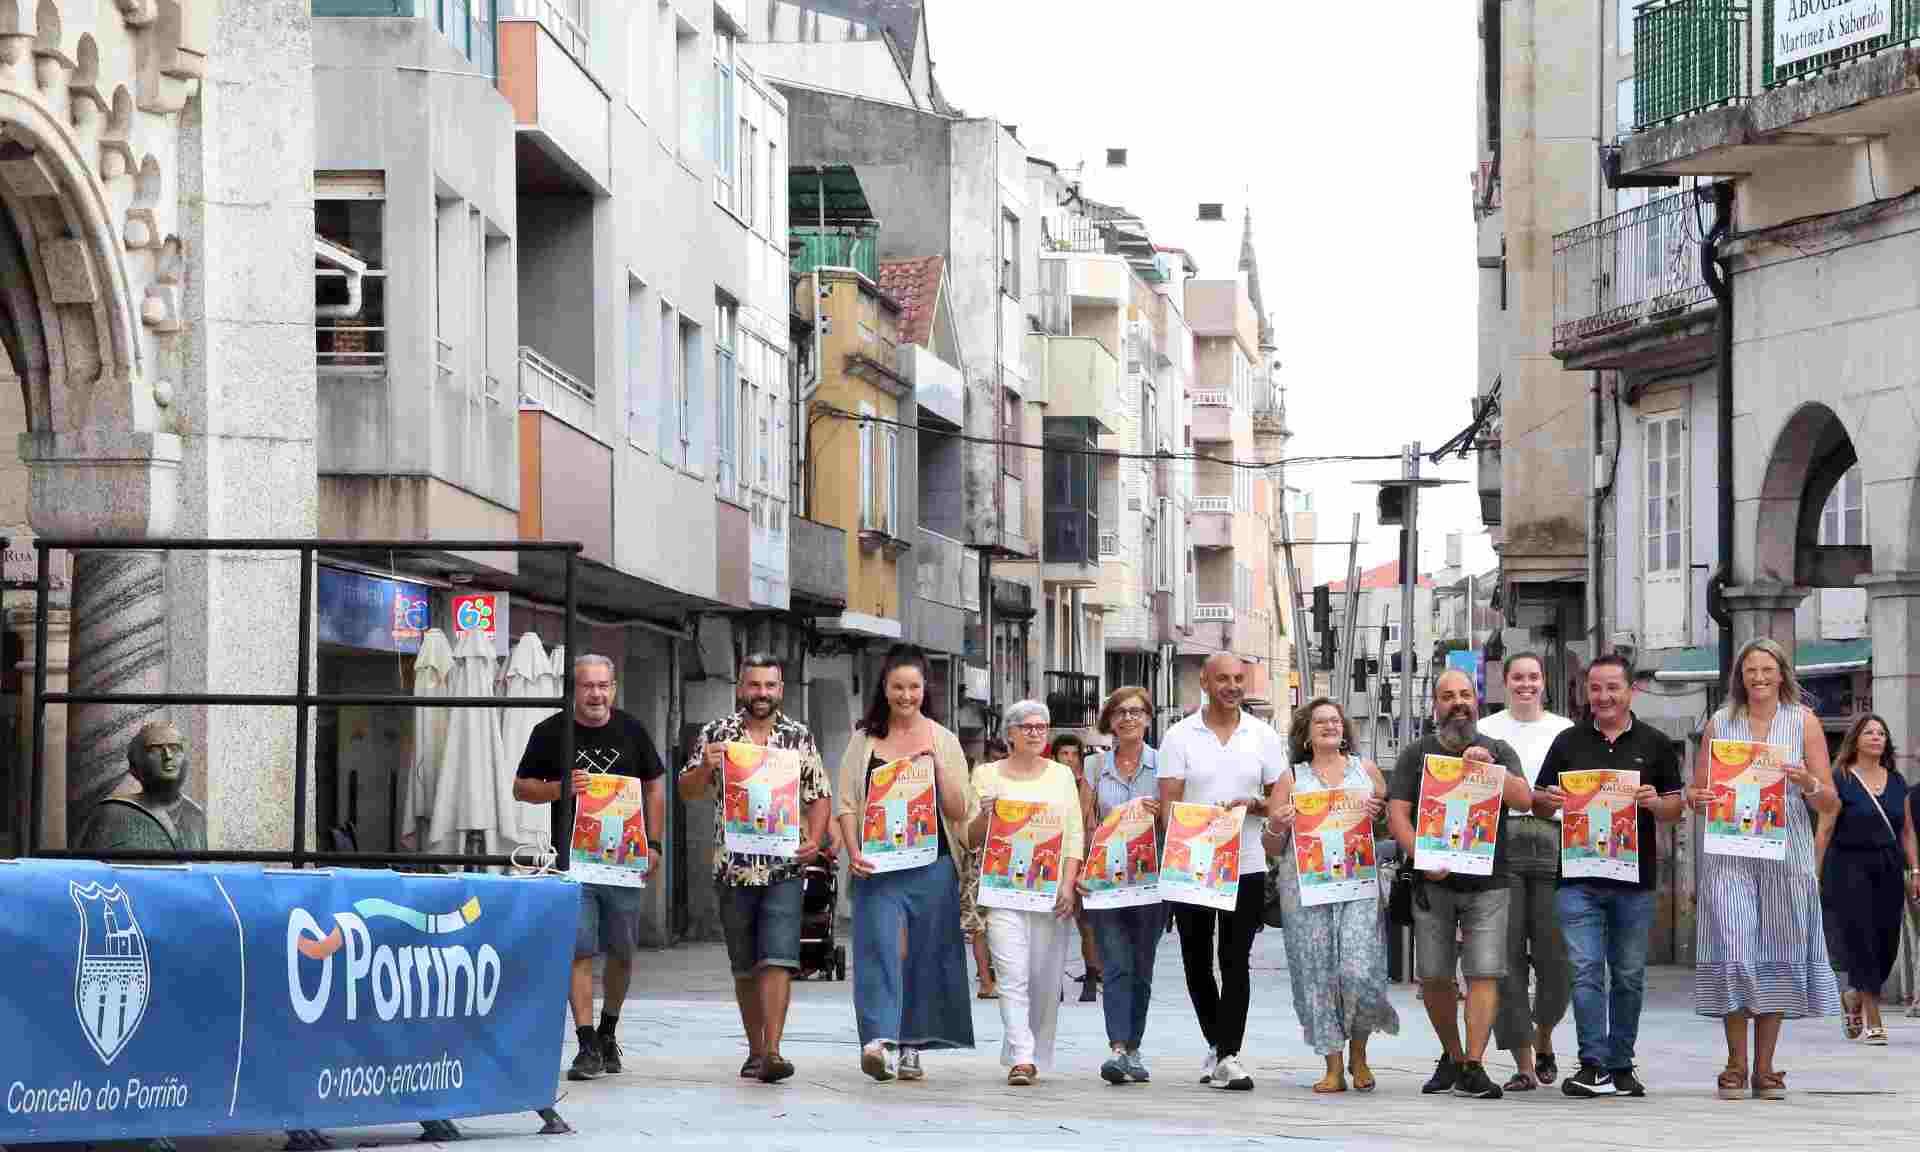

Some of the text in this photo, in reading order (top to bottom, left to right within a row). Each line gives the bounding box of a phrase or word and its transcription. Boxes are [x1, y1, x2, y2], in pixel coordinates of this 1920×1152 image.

[1839, 2, 1884, 37] Saborido
[287, 907, 333, 1024] O
[8, 1077, 188, 1114] Concello do Porriño
